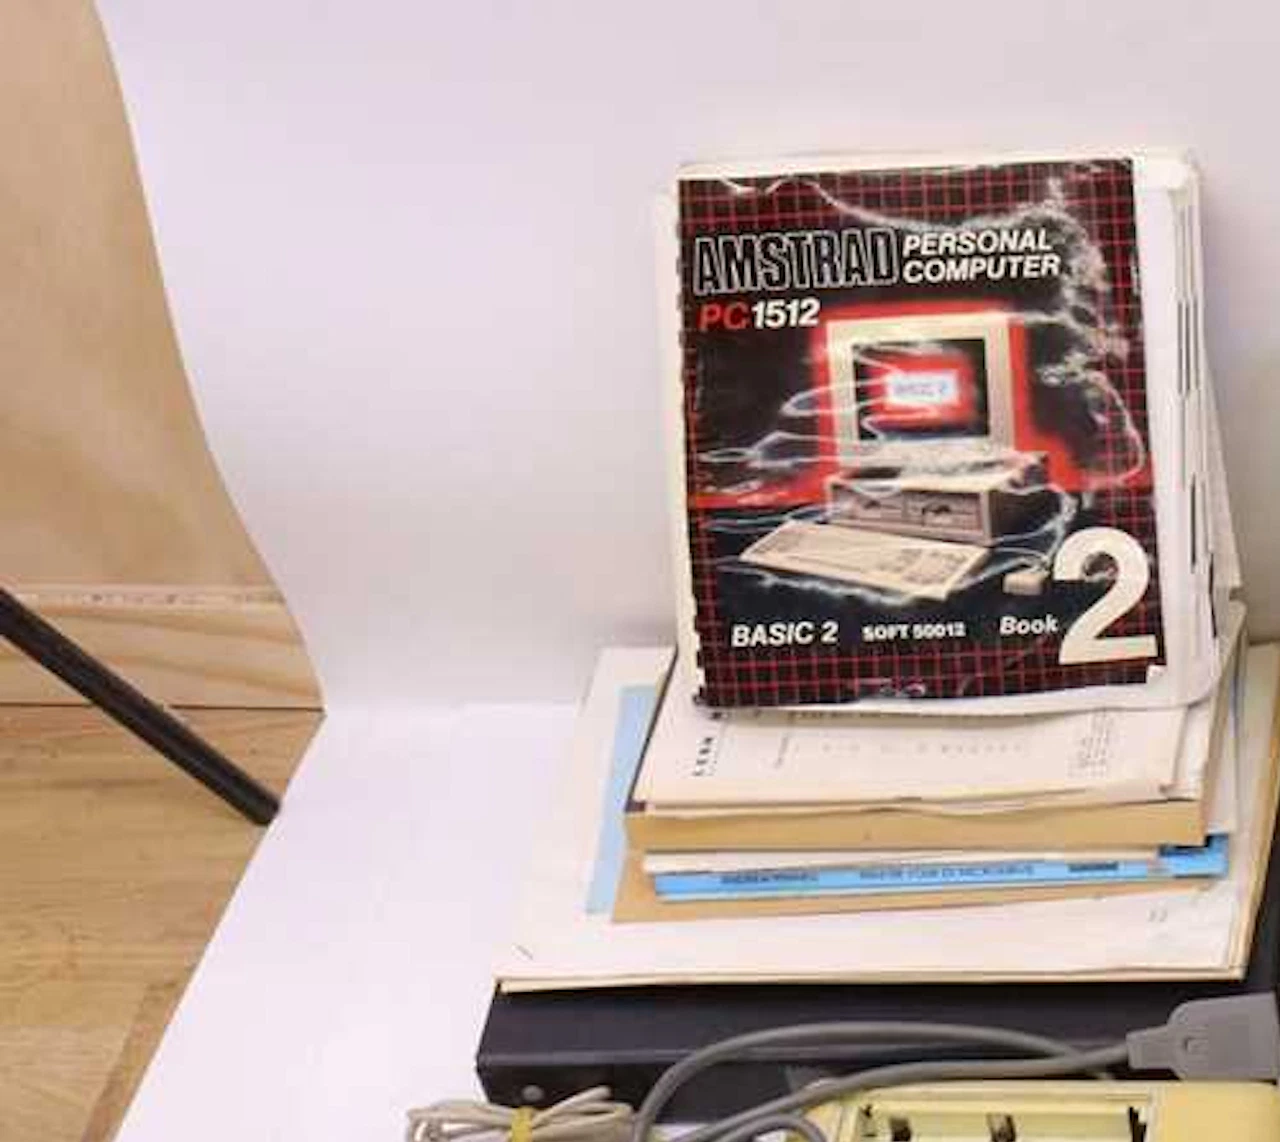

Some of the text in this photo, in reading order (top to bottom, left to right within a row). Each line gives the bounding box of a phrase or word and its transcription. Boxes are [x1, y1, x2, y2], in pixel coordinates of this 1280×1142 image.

[902, 229, 1053, 258] PERSONAL
[694, 226, 898, 296] AMSTRAD
[903, 256, 1060, 285] COMPUTER
[699, 298, 821, 331] PC1512
[1052, 526, 1159, 665] 2
[731, 622, 838, 648] BASIC 2
[862, 624, 909, 641] SOFT
[998, 615, 1059, 636] Book
